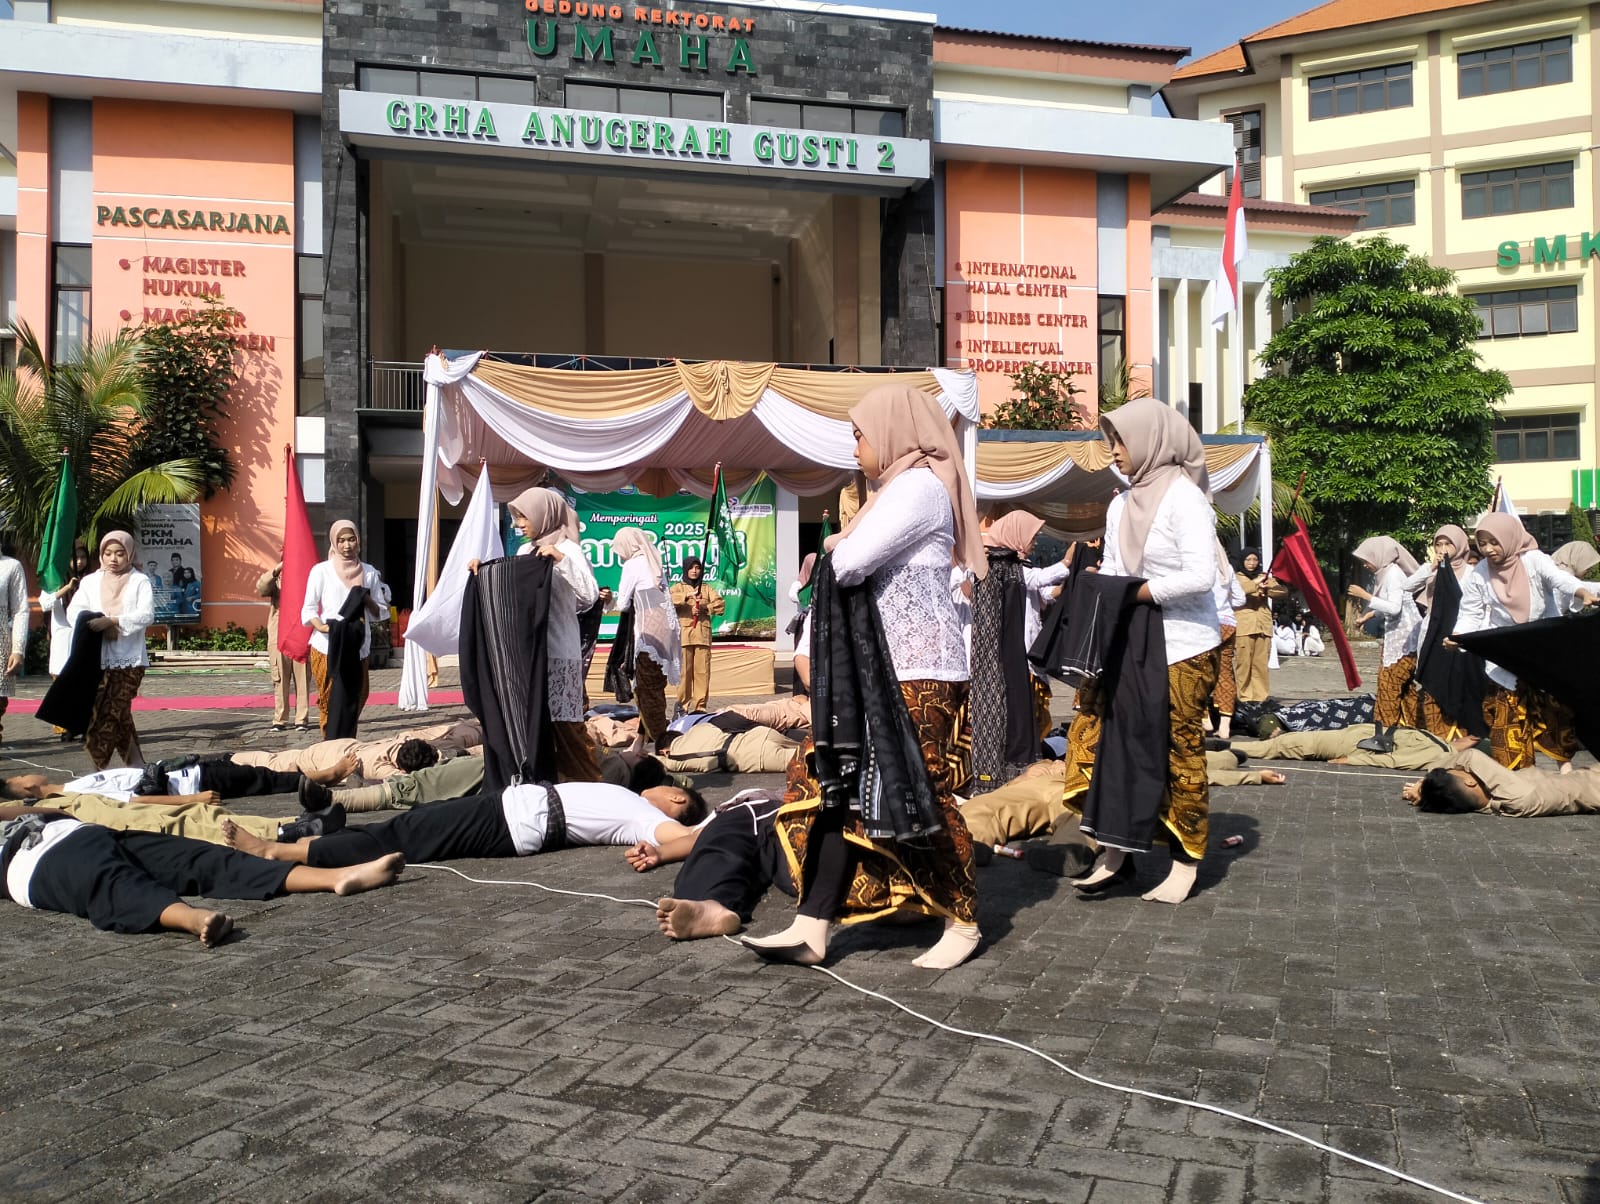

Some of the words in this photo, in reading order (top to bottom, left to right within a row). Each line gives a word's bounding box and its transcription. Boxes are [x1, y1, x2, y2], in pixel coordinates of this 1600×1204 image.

[525, 0, 623, 19] GEDUNG
[634, 7, 755, 32] REKTORAT
[526, 19, 757, 74] UMAHA
[386, 100, 498, 138] GRHA
[522, 111, 731, 157] ANUGERAH
[753, 131, 858, 167] GUSTI
[877, 141, 896, 169] 2
[97, 205, 291, 235] PASCASARJANA
[143, 256, 247, 277] MAGISTER
[967, 261, 1077, 280] INTERNATIONAL
[143, 279, 221, 299] HUKUM
[966, 281, 1011, 296] HALAL
[1016, 283, 1068, 298] CENTER
[967, 311, 1031, 326] BUSINESS
[1037, 313, 1088, 328] CENTER
[967, 340, 1064, 356] INTELLECTUAL
[967, 359, 1034, 374] PROPERT
[589, 513, 658, 526] Memperingati
[142, 530, 173, 538] PKM
[664, 523, 704, 536] 2025
[142, 538, 194, 546] UMAHA
